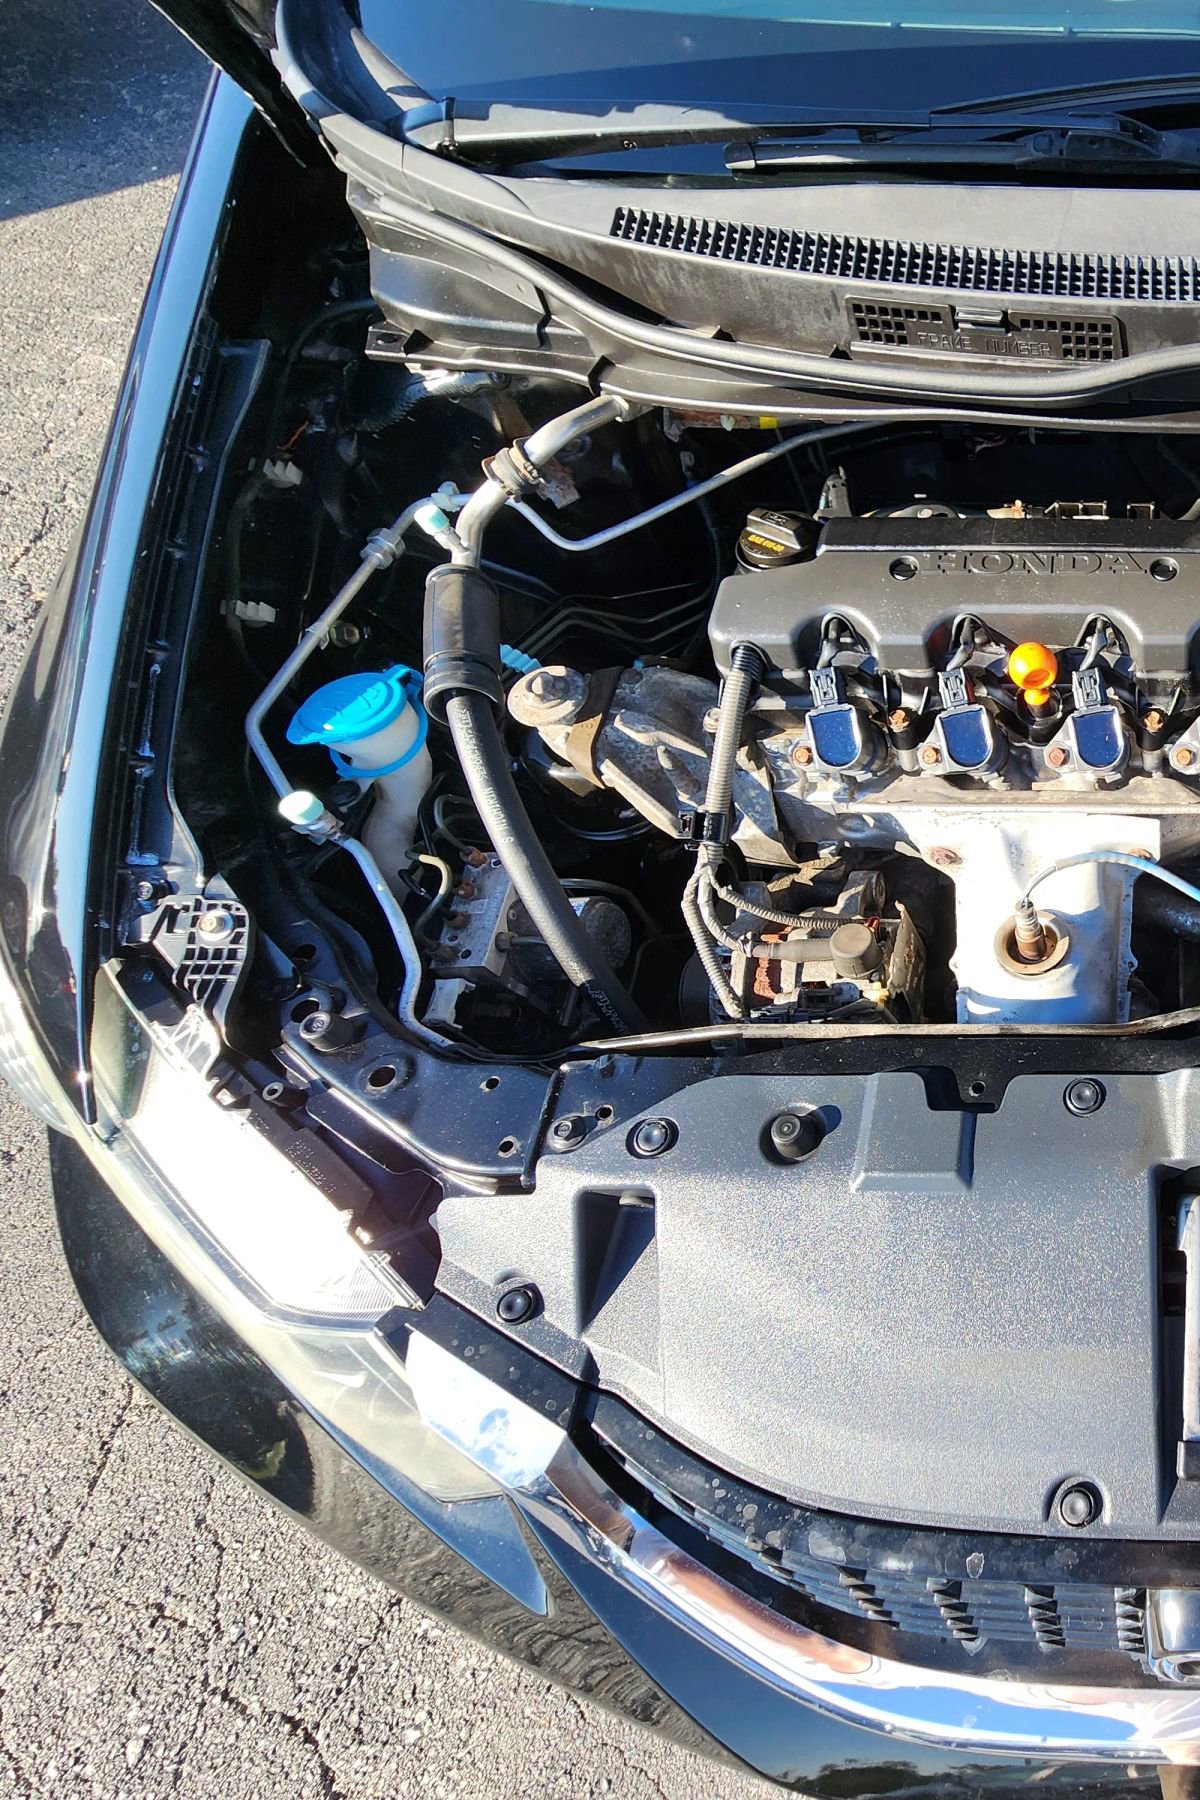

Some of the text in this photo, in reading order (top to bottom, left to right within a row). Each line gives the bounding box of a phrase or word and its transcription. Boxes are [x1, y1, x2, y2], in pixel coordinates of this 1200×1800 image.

[917, 332, 1051, 356] FRAME NUMBER
[922, 551, 1148, 575] HONDA
